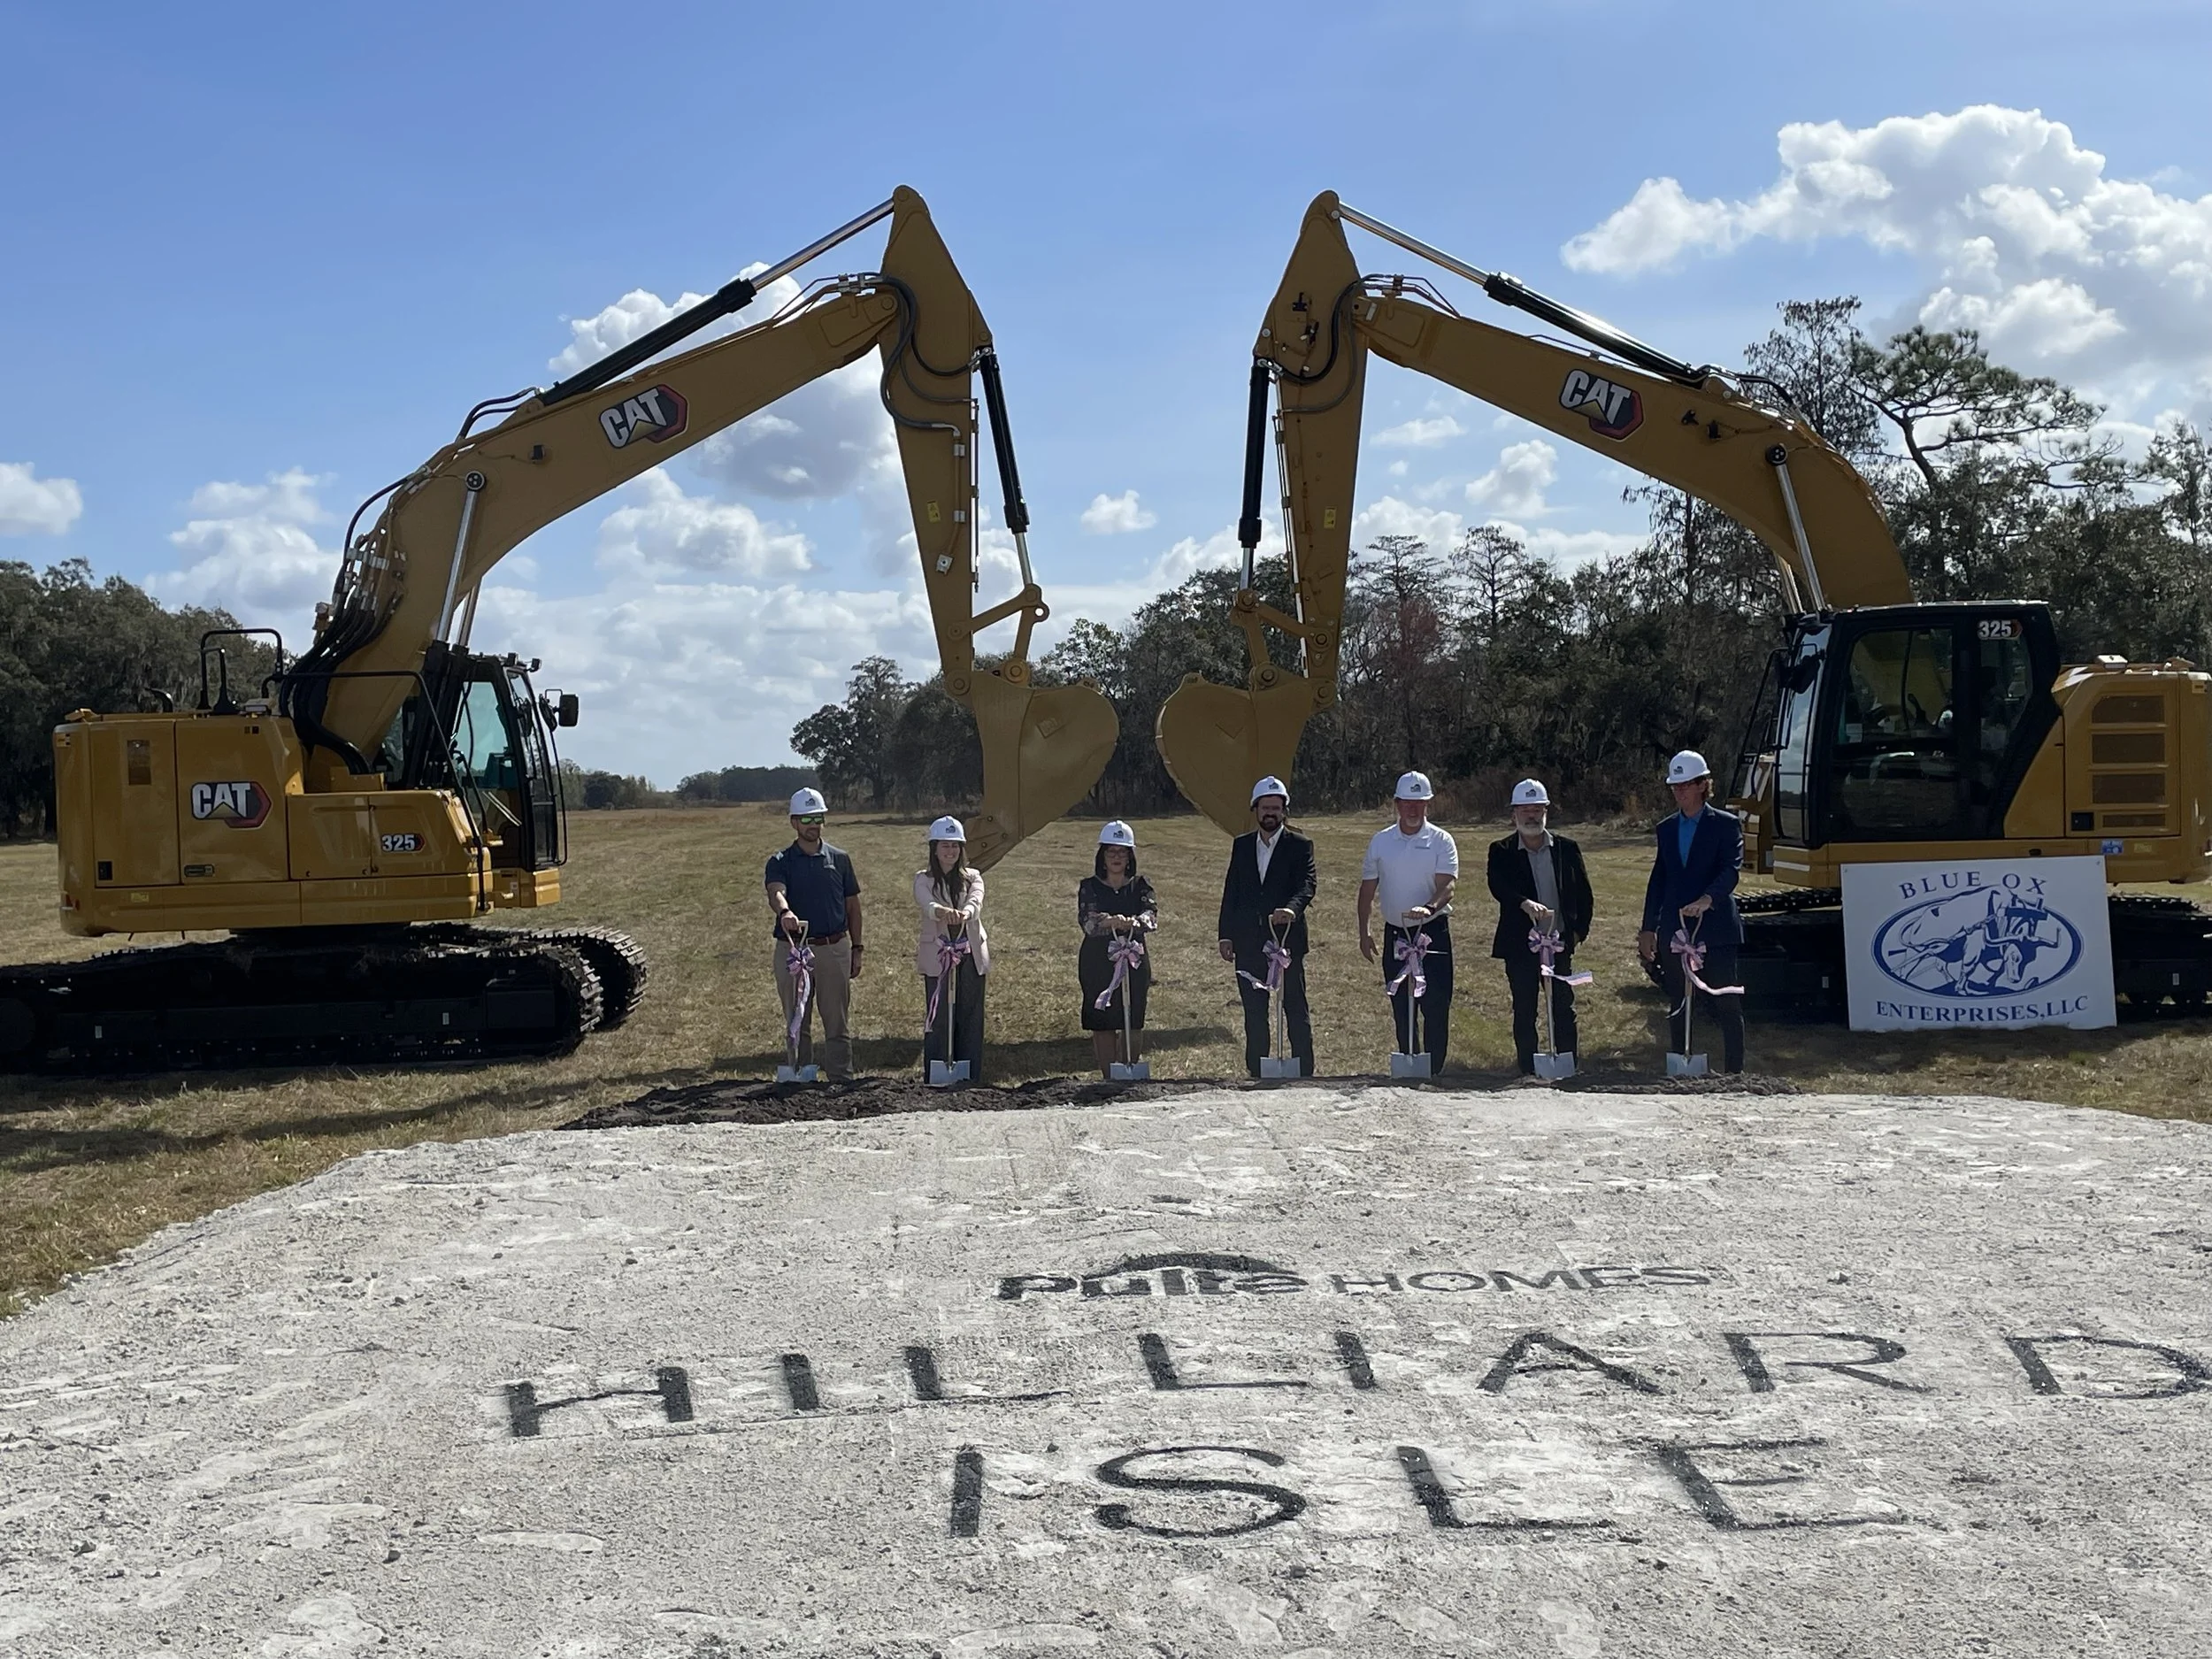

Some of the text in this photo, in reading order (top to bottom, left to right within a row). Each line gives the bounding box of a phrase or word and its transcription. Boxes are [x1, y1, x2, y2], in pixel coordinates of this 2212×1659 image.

[1560, 369, 1632, 425] CAT
[600, 388, 667, 448] CAT
[1978, 619, 2012, 638] 325
[191, 782, 251, 819] CAT
[381, 833, 416, 851] 325
[1899, 871, 2047, 900] BLUE OX
[1329, 1266, 1711, 1294] HOMES
[503, 1331, 2212, 1438] HILLIARD
[949, 1436, 1916, 1539] ISLE
